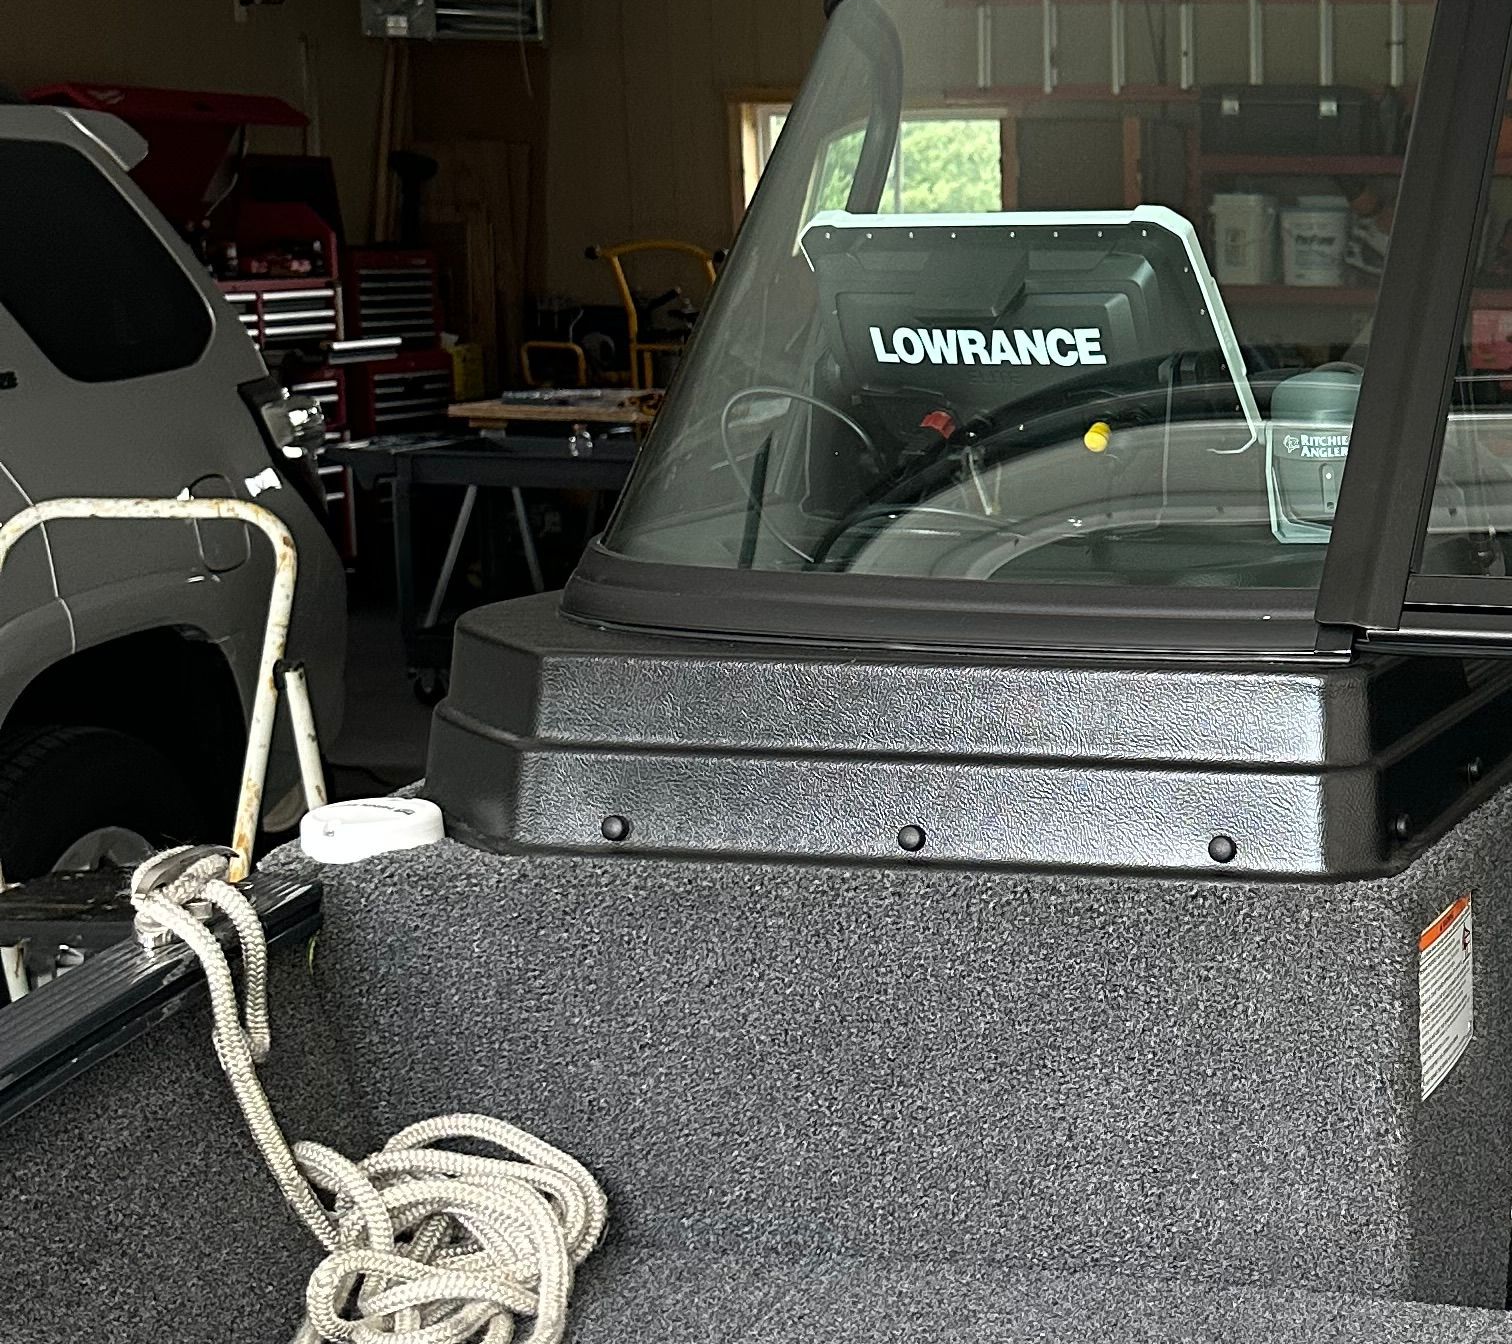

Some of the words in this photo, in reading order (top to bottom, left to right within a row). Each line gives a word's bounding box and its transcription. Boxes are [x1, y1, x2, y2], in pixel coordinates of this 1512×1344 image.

[869, 327, 1107, 367] LOWRANCE
[1300, 434, 1350, 447] RITCHIE
[1300, 445, 1348, 458] ANGLER
